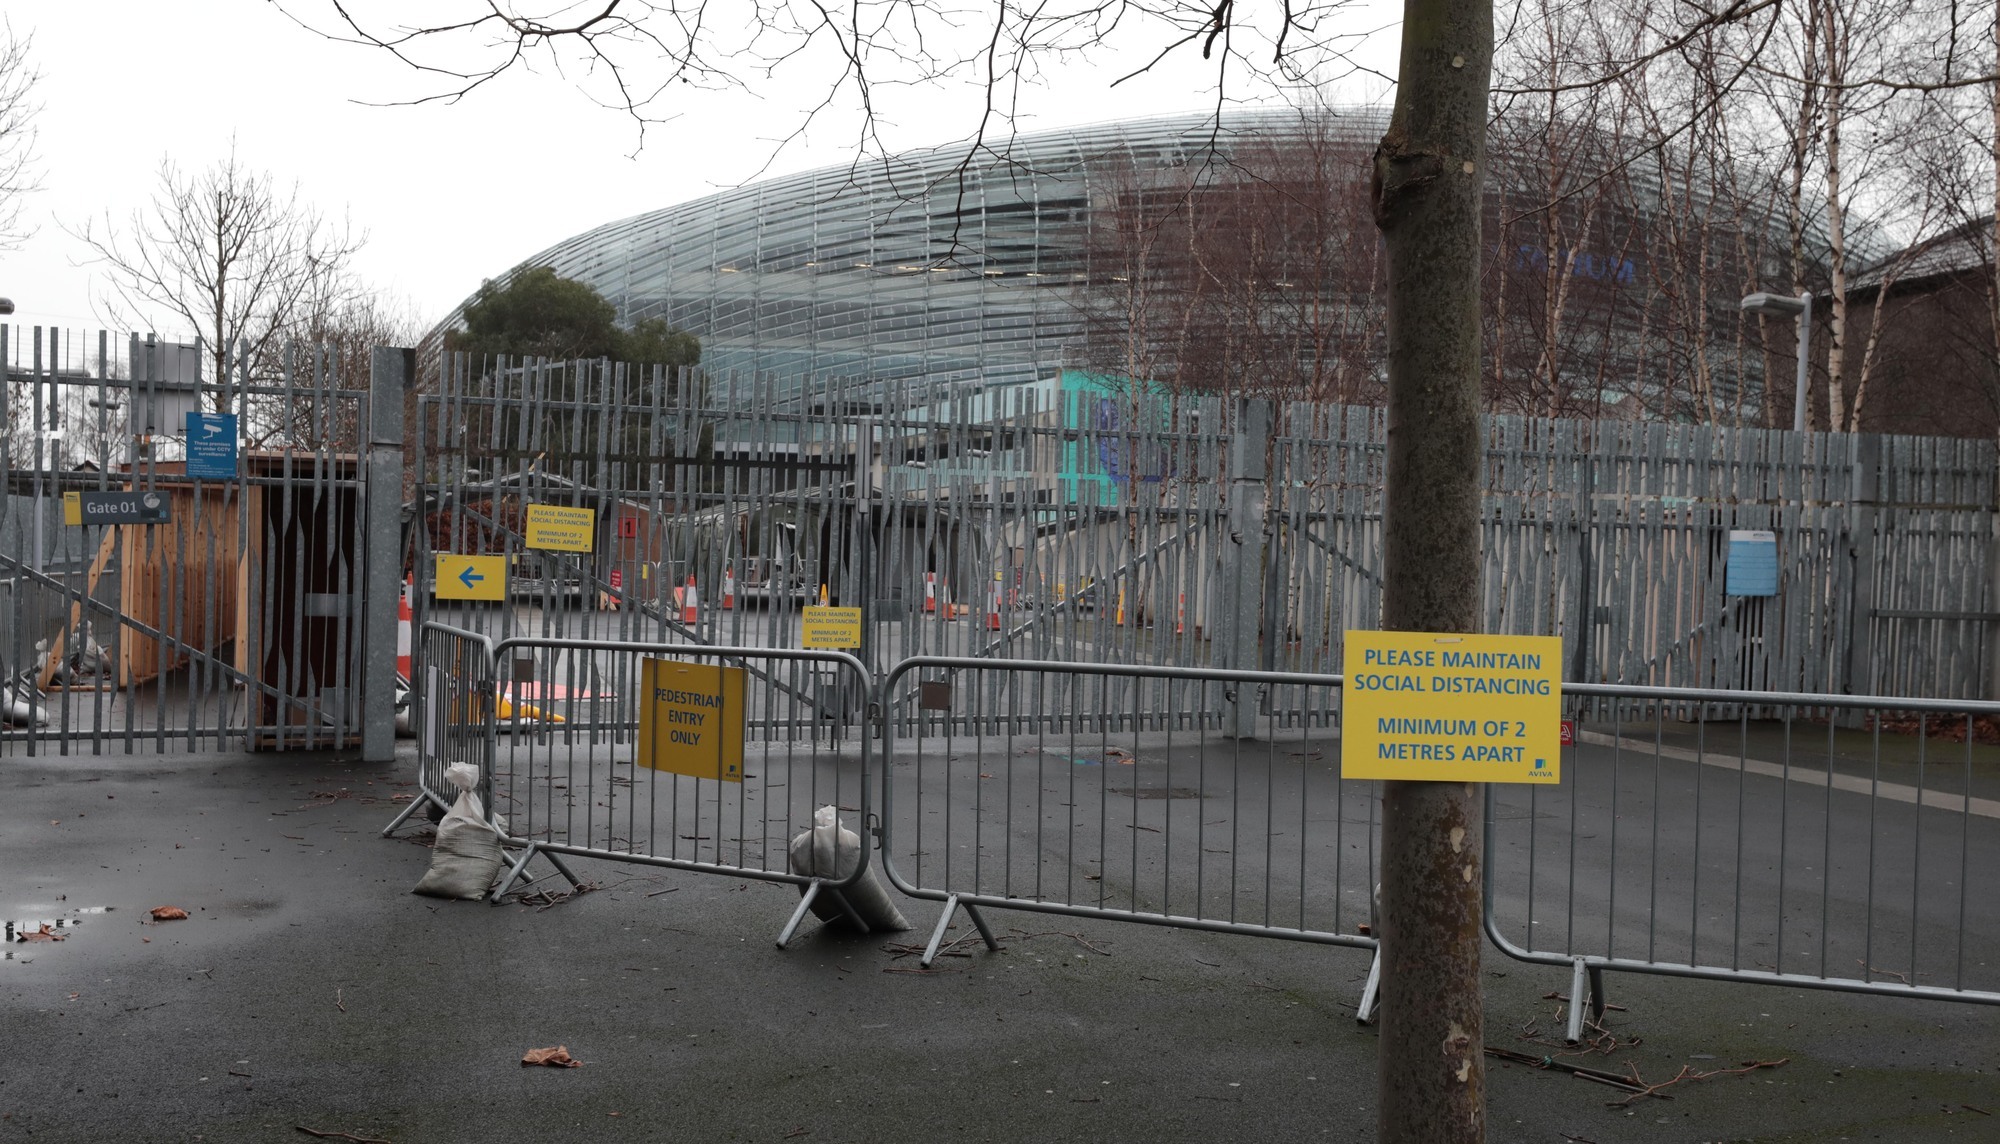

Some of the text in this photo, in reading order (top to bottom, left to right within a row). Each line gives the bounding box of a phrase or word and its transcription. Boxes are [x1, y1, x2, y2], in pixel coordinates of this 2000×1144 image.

[87, 501, 137, 514] Gate 01
[557, 511, 588, 519] MAINTAIN
[554, 518, 590, 526] DISTANCING
[625, 521, 631, 534] 1
[1364, 649, 1542, 670] PLEASE MAINTAIN
[1354, 674, 1551, 696] SOCIAL DISTANCING
[655, 687, 725, 709] PEDESTRIAN
[668, 709, 705, 727] ENTRY
[1377, 718, 1526, 737] MINIMUM OF 2
[670, 730, 702, 746] ONLY
[1378, 743, 1525, 763] METRES APART
[1528, 770, 1553, 778] AVIVA
